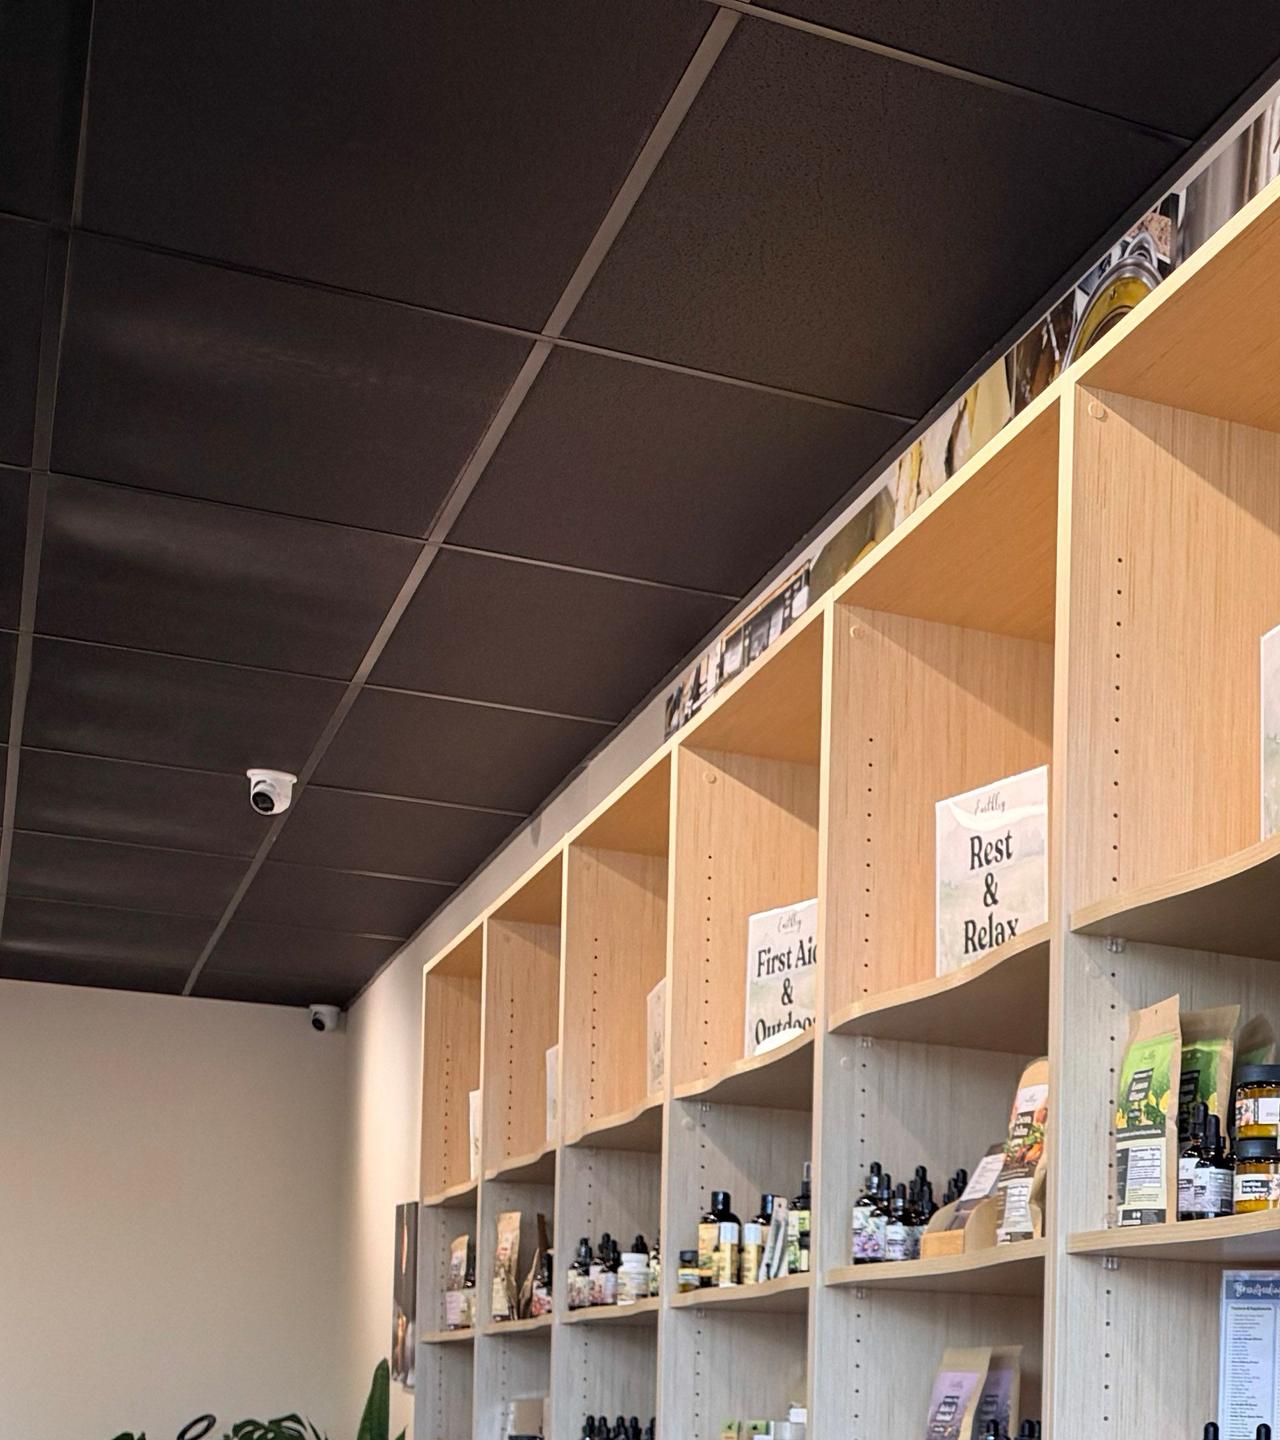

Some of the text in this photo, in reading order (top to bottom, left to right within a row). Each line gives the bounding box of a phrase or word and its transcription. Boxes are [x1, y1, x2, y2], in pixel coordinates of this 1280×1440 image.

[969, 830, 1014, 871] Rest
[983, 872, 1000, 907] &
[963, 915, 1020, 954] Relax
[757, 940, 792, 978] First
[781, 977, 794, 1006] &
